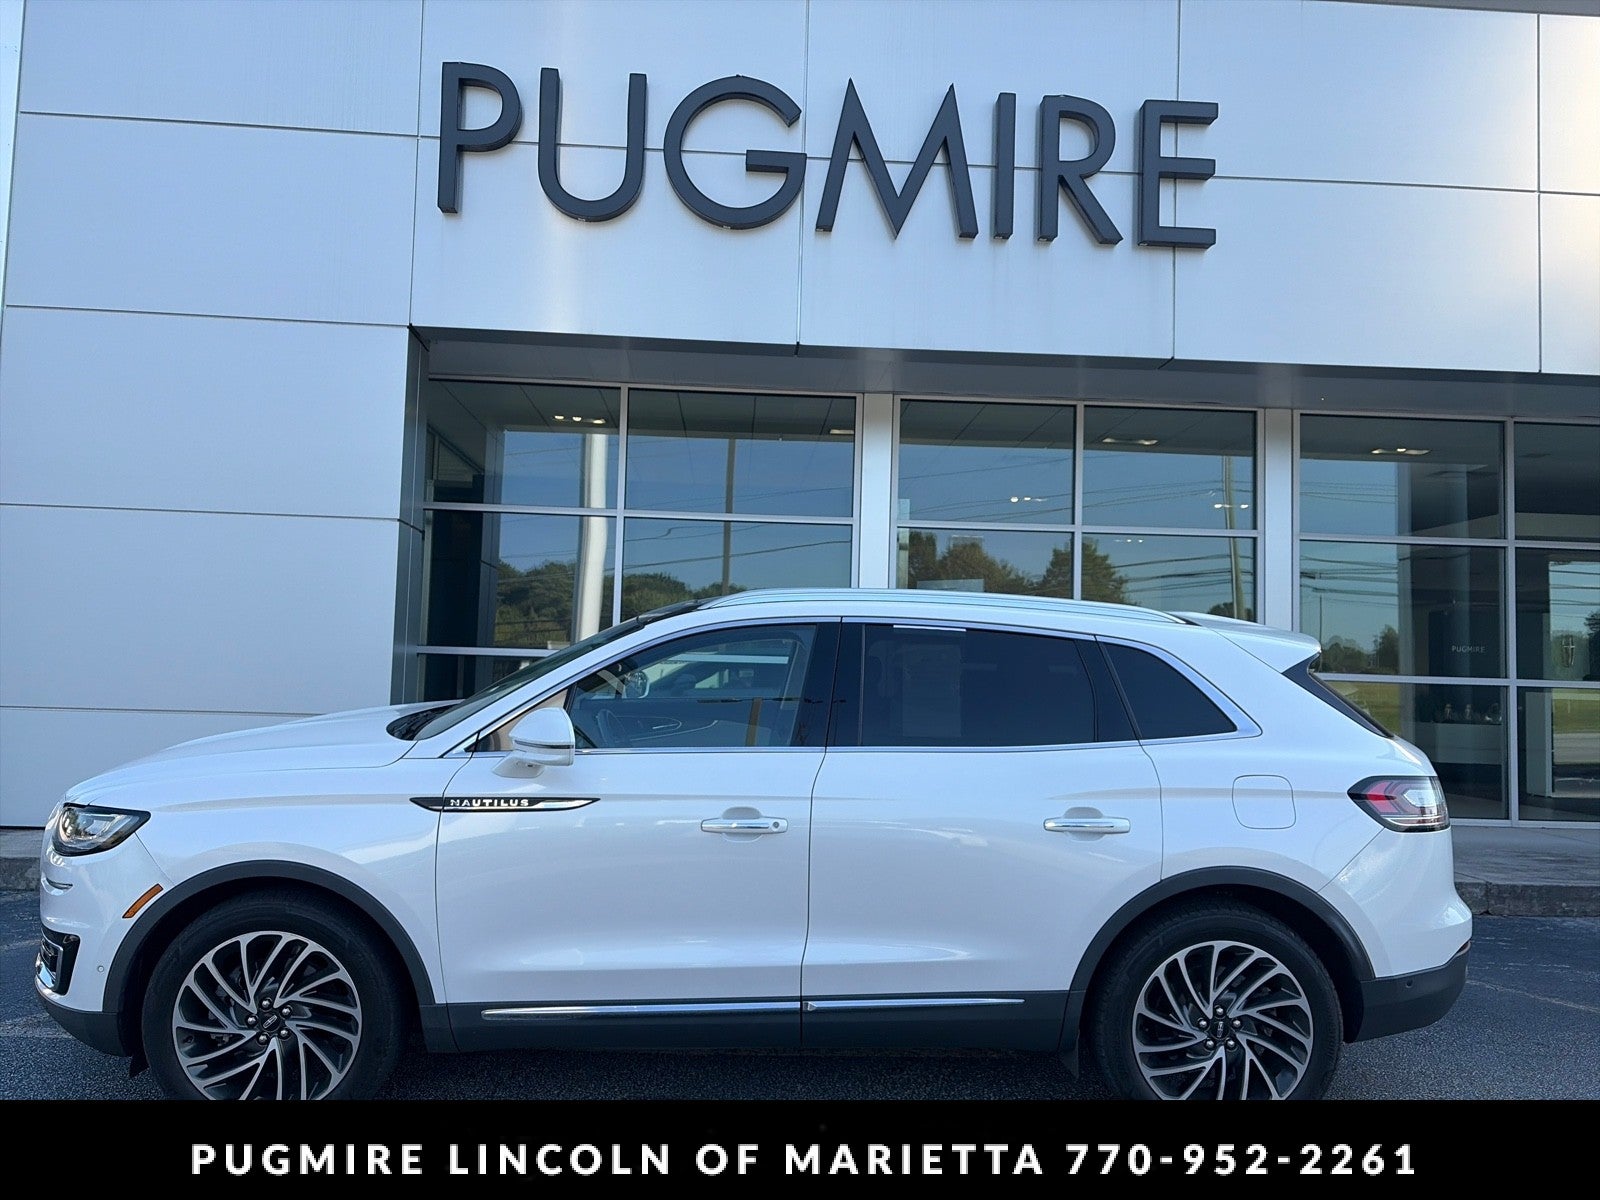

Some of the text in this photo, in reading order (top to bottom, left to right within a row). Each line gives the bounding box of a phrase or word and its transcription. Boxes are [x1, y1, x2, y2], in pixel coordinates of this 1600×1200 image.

[437, 61, 1219, 248] PUGMIRE
[1451, 645, 1486, 653] PUGMIRE
[449, 798, 530, 807] NAUTILUS
